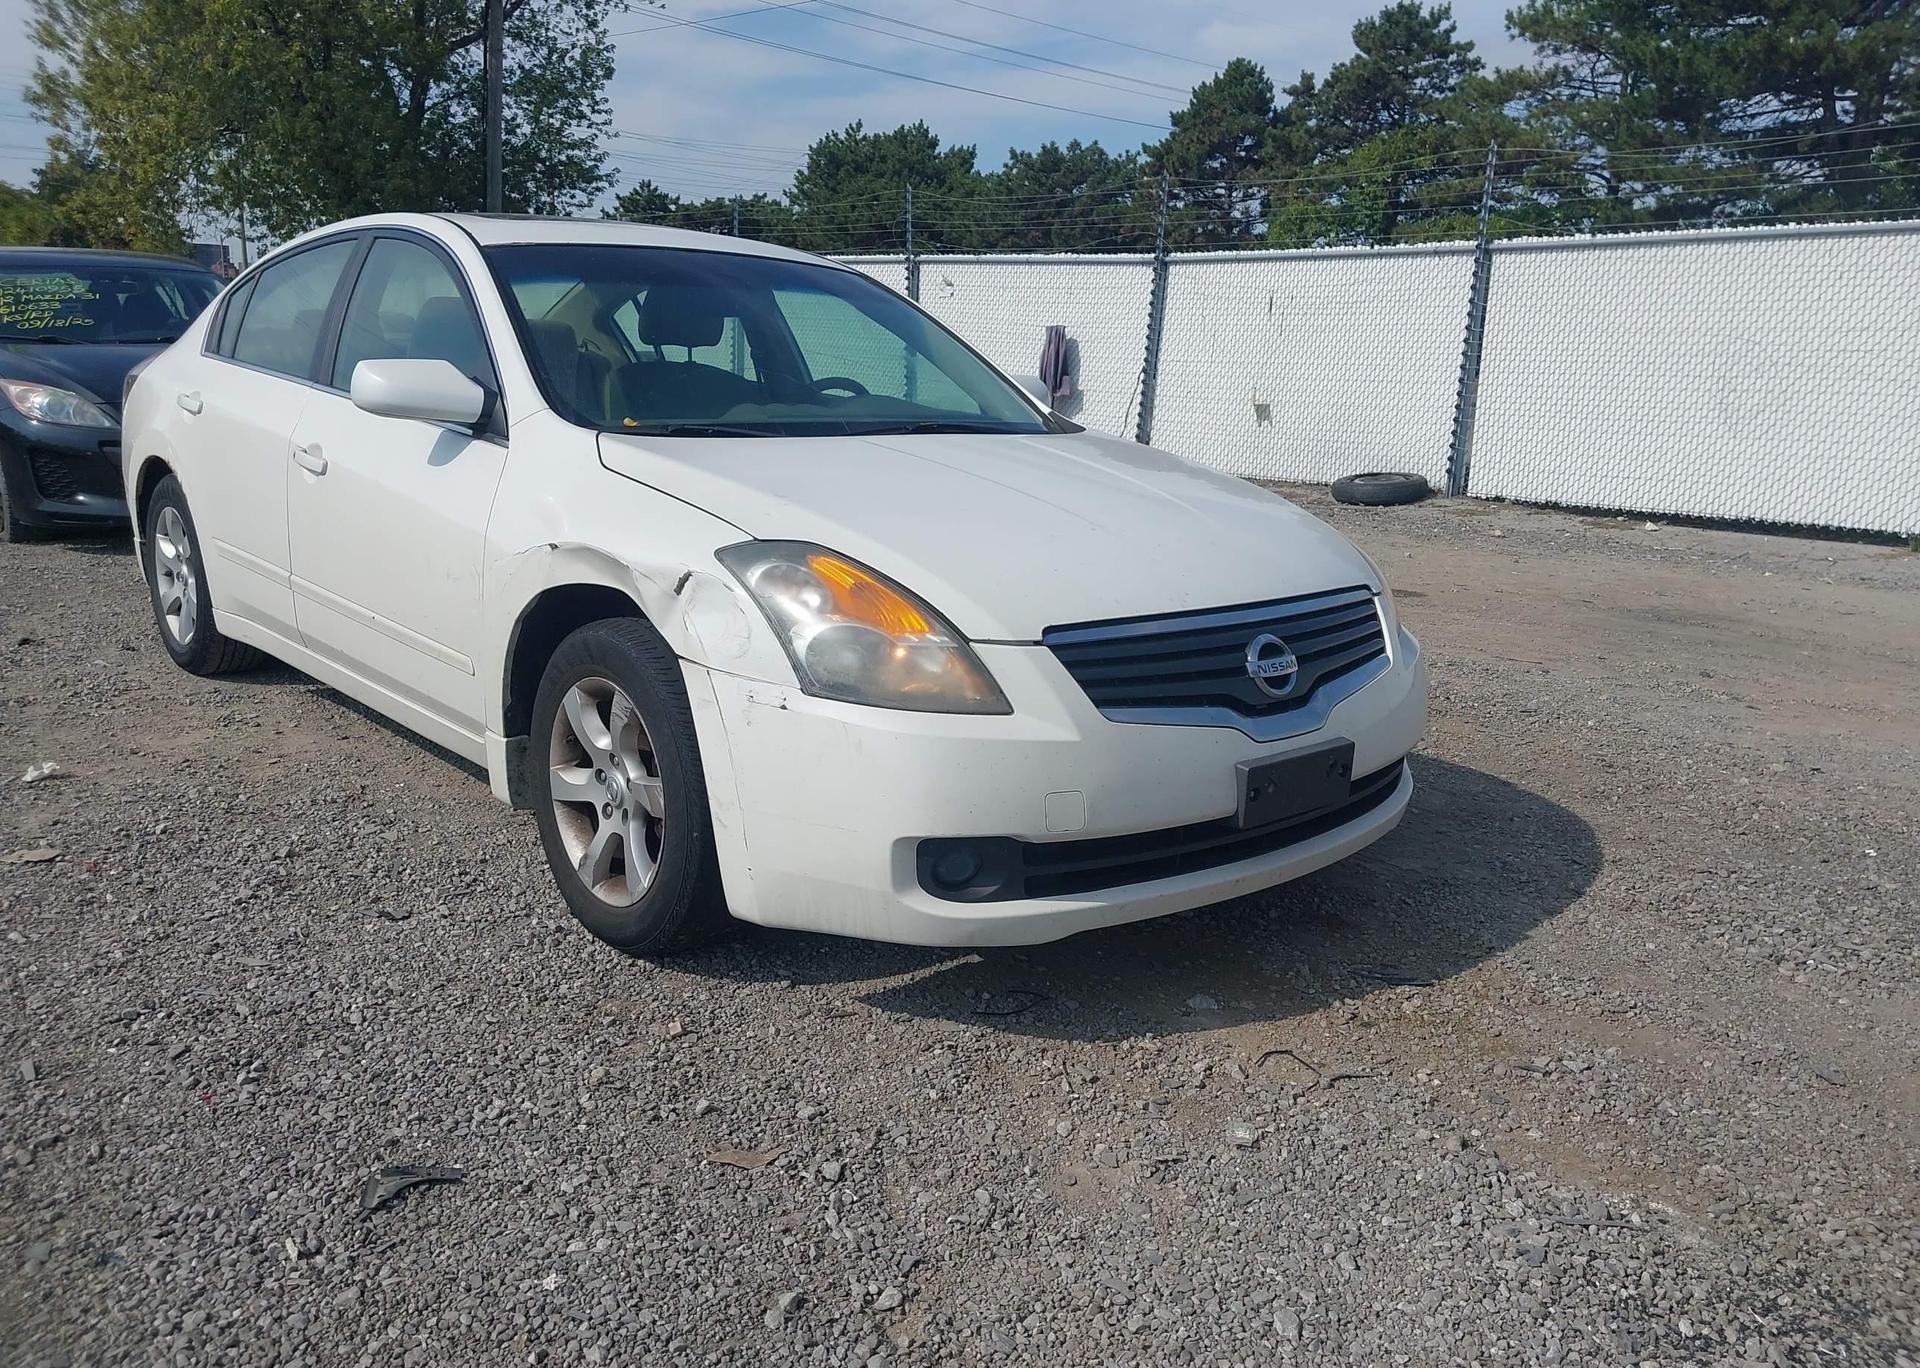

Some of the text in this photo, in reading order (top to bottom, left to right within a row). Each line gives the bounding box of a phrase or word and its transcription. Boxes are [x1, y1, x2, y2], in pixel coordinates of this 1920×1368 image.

[21, 293, 76, 302] MAZDA
[17, 316, 95, 329] 09/18/25
[1257, 660, 1297, 674] NISSAN
